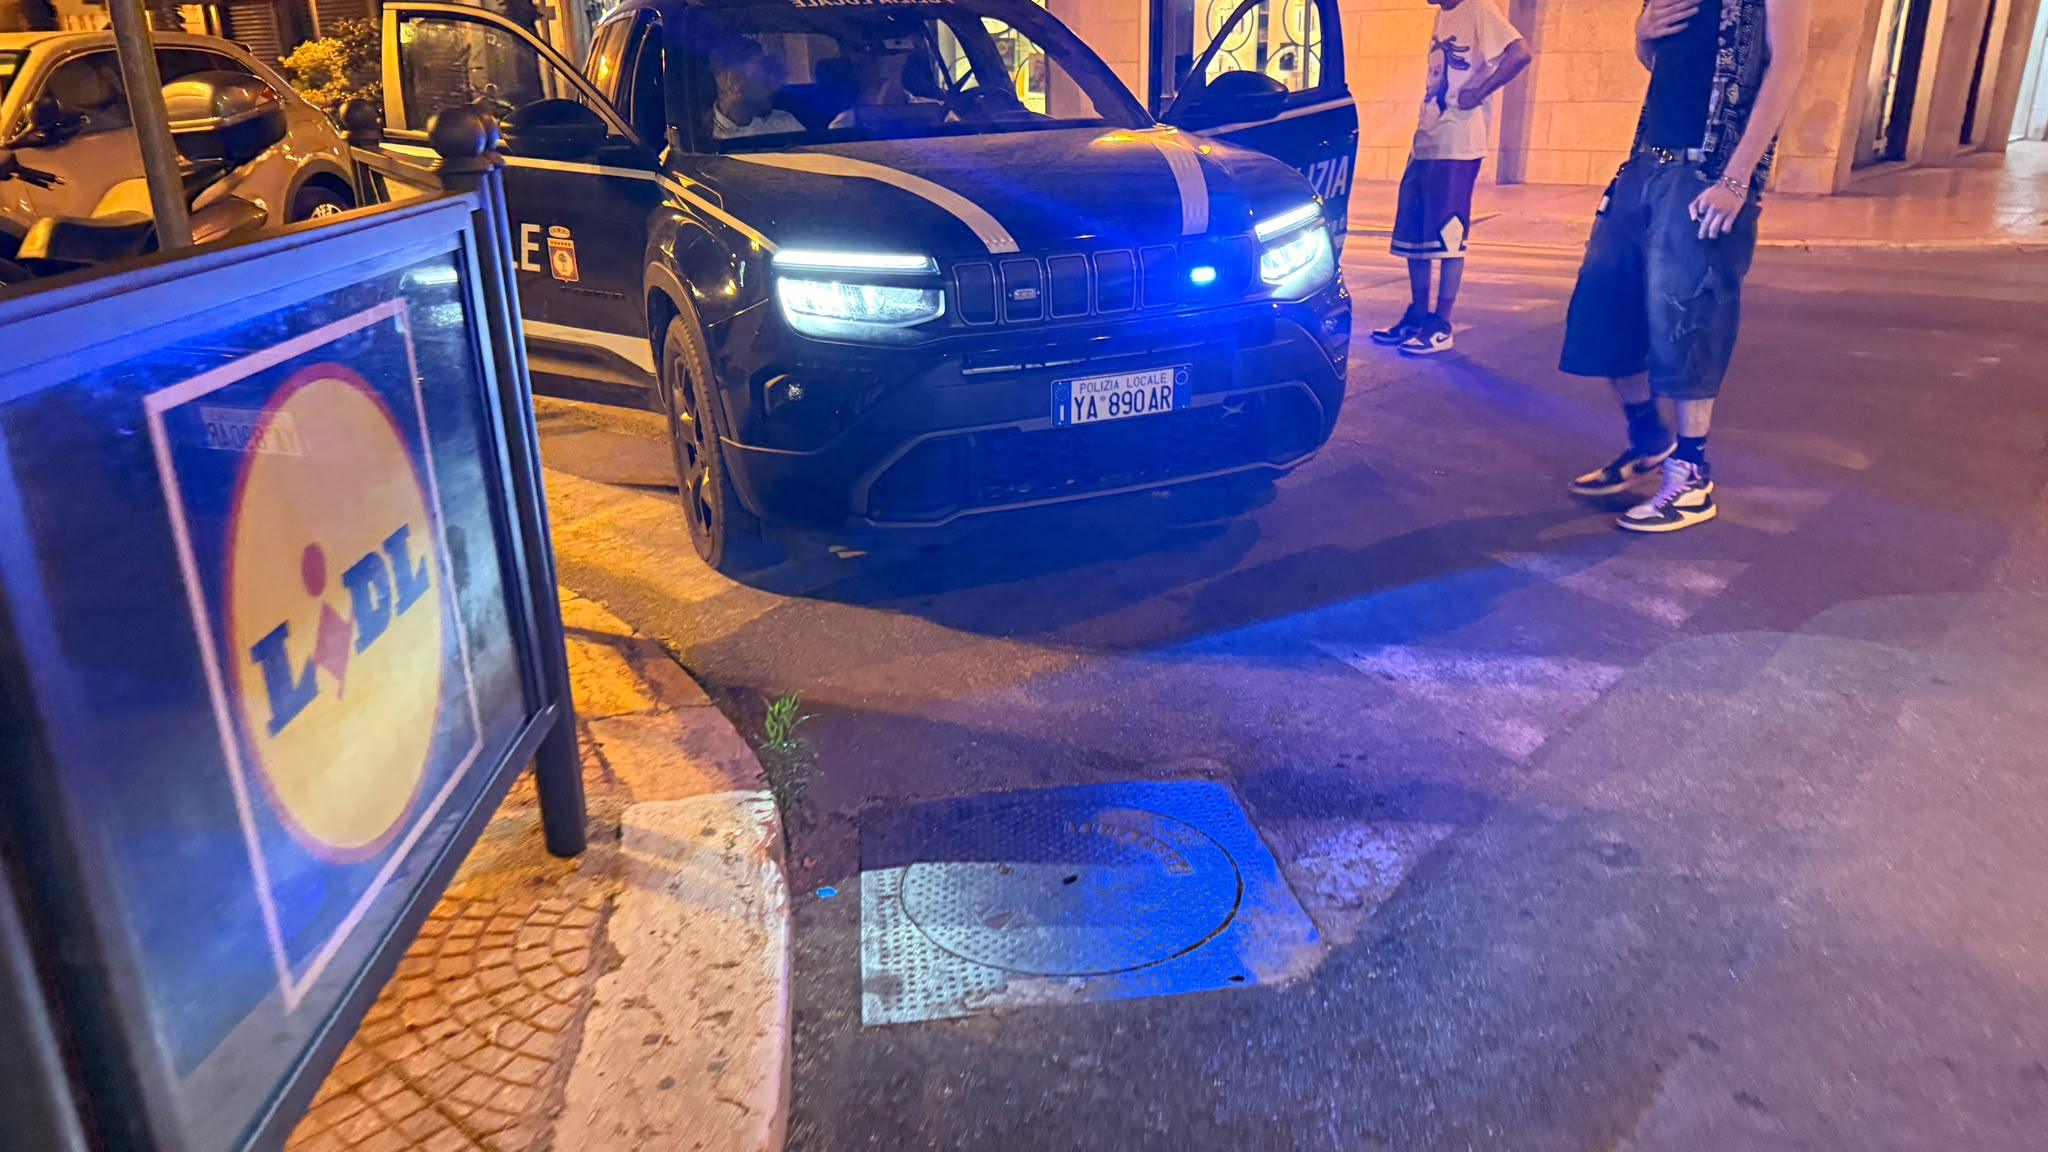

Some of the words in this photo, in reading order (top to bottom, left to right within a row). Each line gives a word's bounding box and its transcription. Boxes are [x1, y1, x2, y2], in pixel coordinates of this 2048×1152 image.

[513, 223, 541, 272] E
[1080, 380, 1120, 394] POLIZIA
[1126, 372, 1168, 389] LOCALE
[1074, 395, 1098, 421] YA
